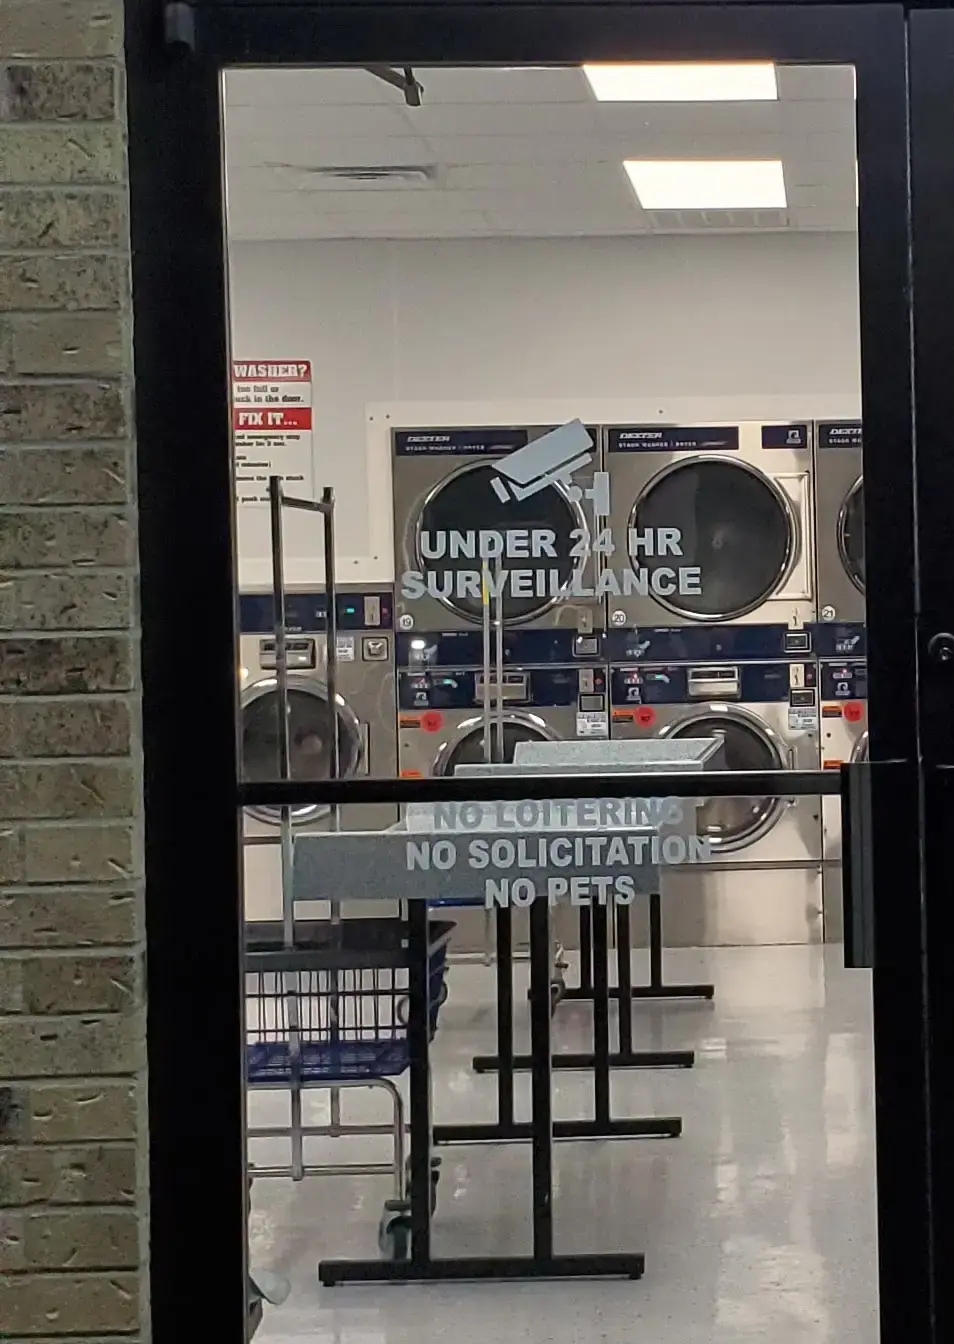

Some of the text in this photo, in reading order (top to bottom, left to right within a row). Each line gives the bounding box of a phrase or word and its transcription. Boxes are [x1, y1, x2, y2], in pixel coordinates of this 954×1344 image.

[234, 364, 308, 378] WASHER?
[265, 394, 279, 402] the
[238, 411, 263, 426] FIX
[420, 527, 684, 560] UNDER 24 HR
[401, 566, 703, 599] SURVEILLANCE
[614, 613, 626, 622] 20
[823, 609, 834, 618] 21
[401, 617, 412, 626] 19
[433, 797, 684, 830] NO LOITERING
[406, 835, 712, 871] NO SOLICITATION
[485, 875, 636, 909] NO PETS
